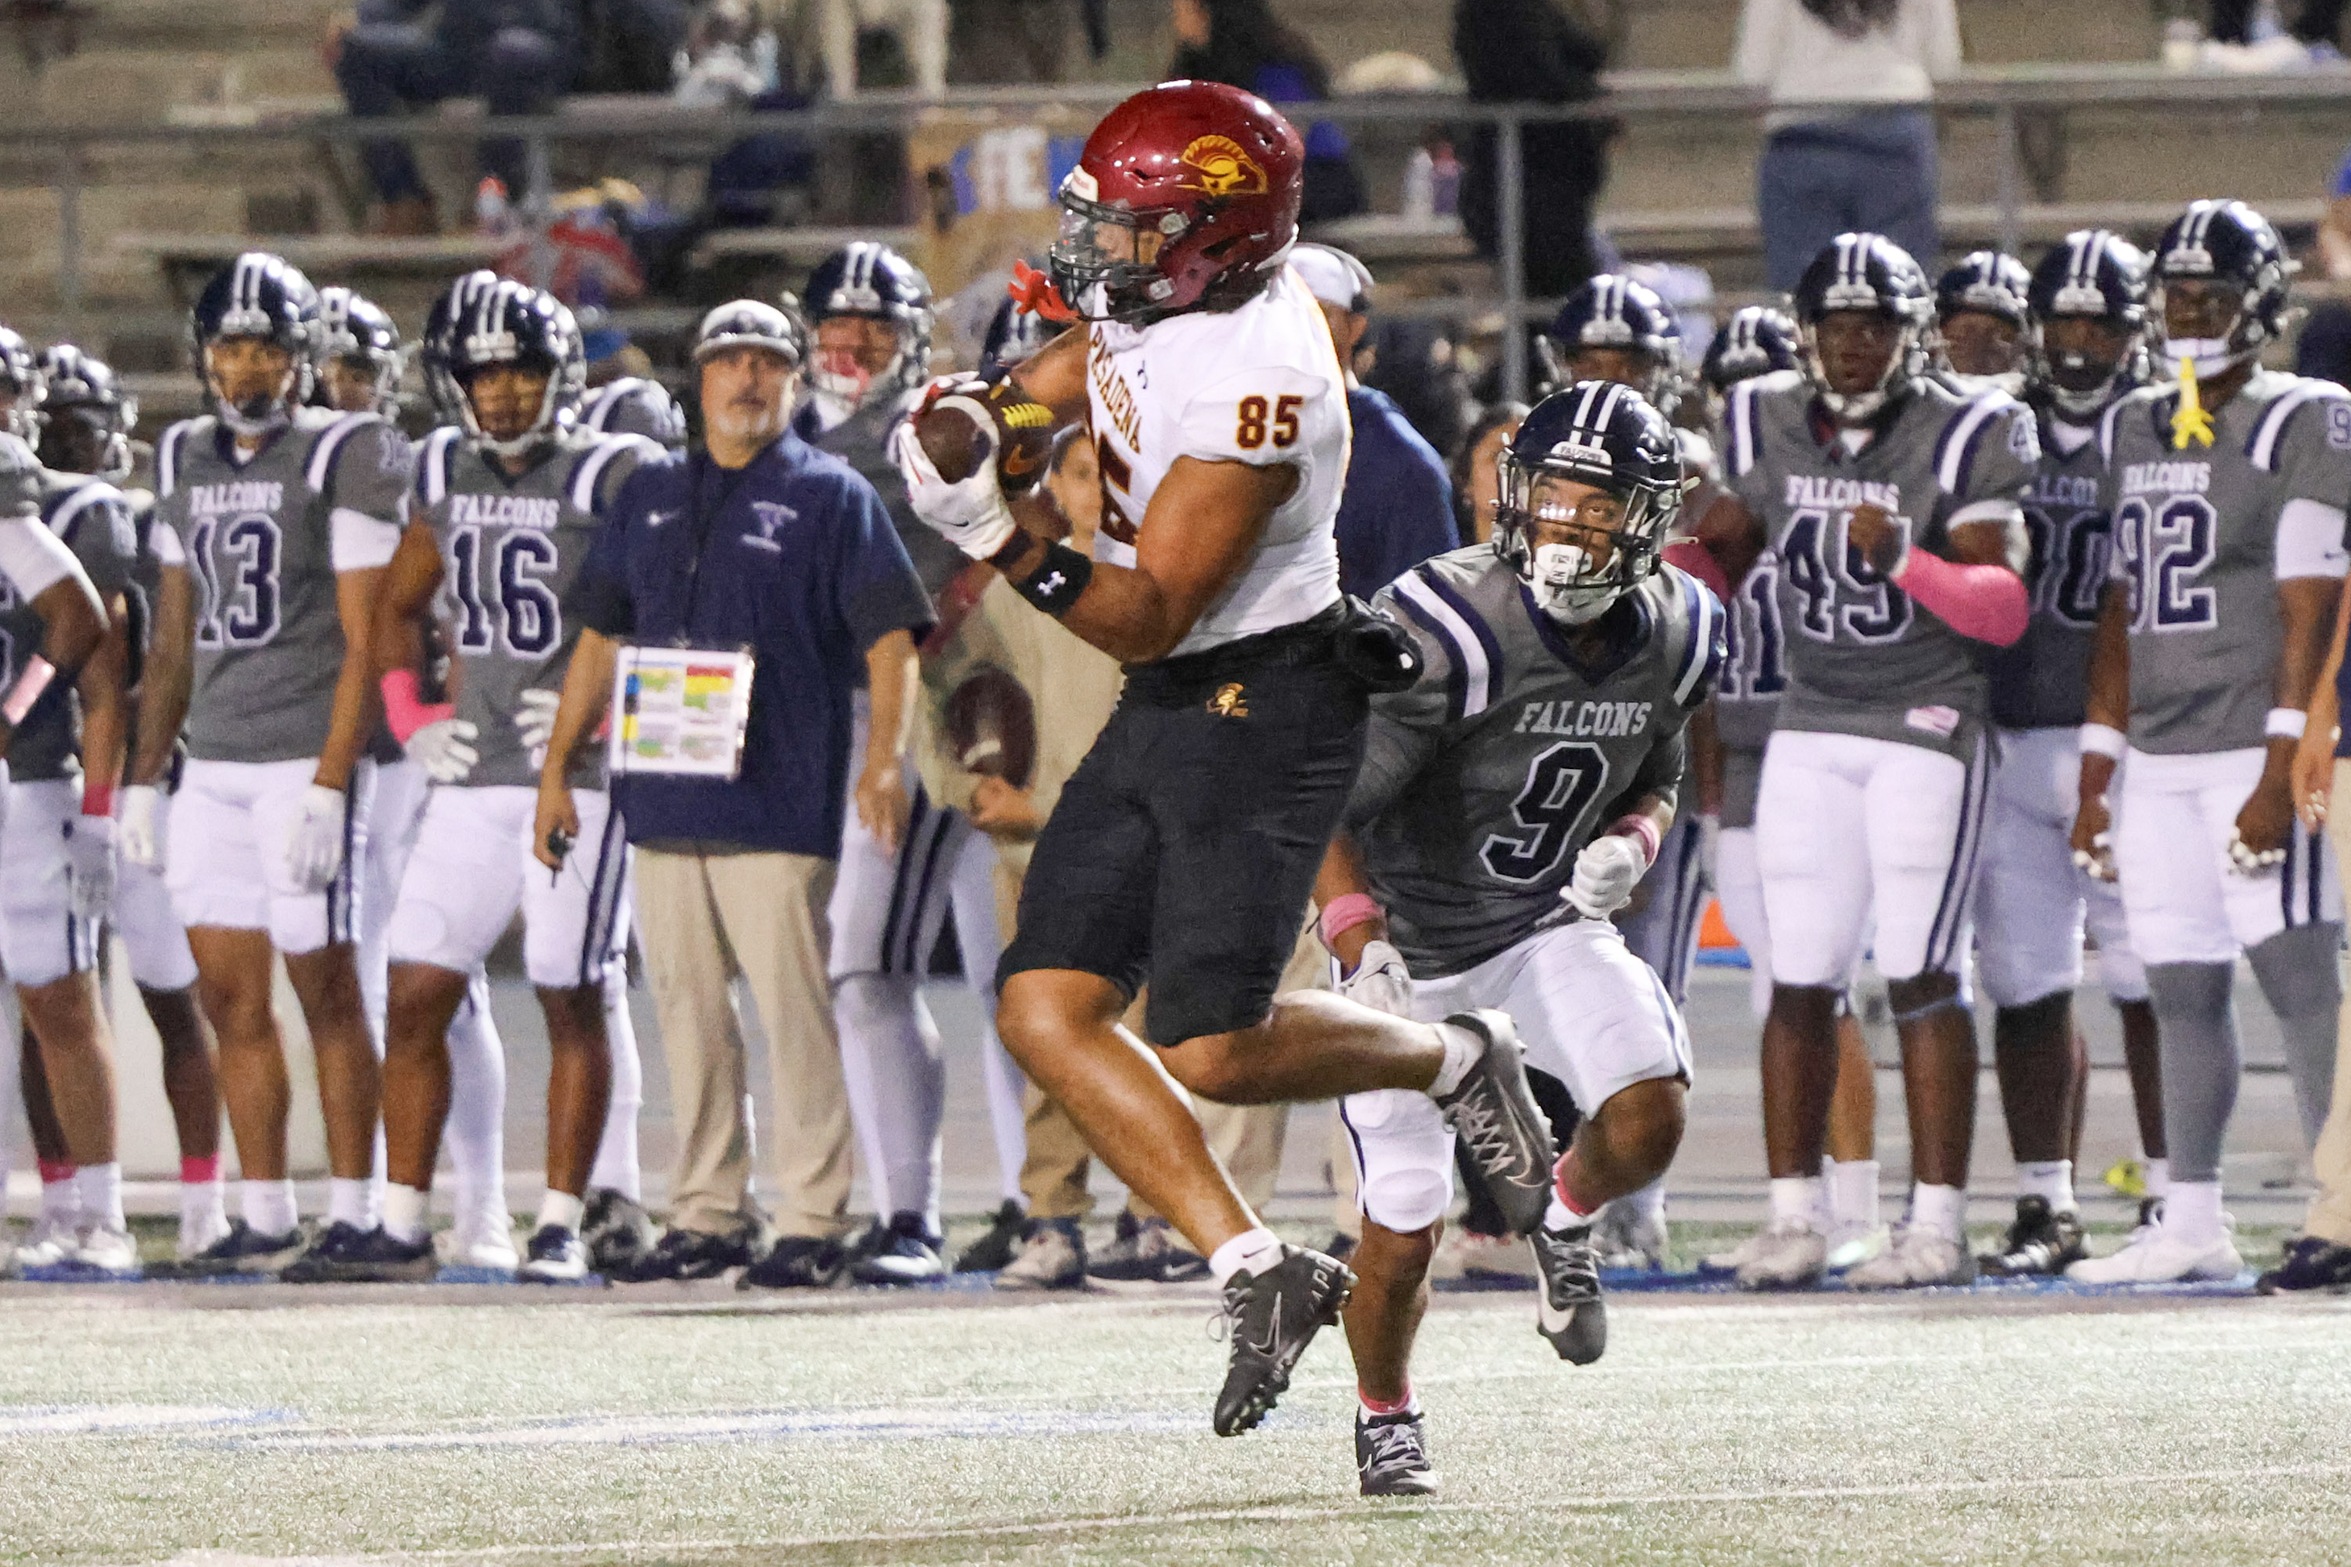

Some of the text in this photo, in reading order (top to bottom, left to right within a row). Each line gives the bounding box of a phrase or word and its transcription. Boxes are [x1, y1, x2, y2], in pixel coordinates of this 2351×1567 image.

[1236, 394, 1304, 449] 85
[190, 480, 283, 516] FALCONS
[1785, 475, 1899, 513] FALCONS
[2122, 462, 2212, 493] FALCONS
[450, 494, 559, 530] FALCONS
[187, 512, 283, 648] 13
[2113, 494, 2217, 634] 92
[448, 524, 562, 660] 16
[1514, 701, 1652, 736] FALCONS
[1480, 741, 1609, 884] 9
